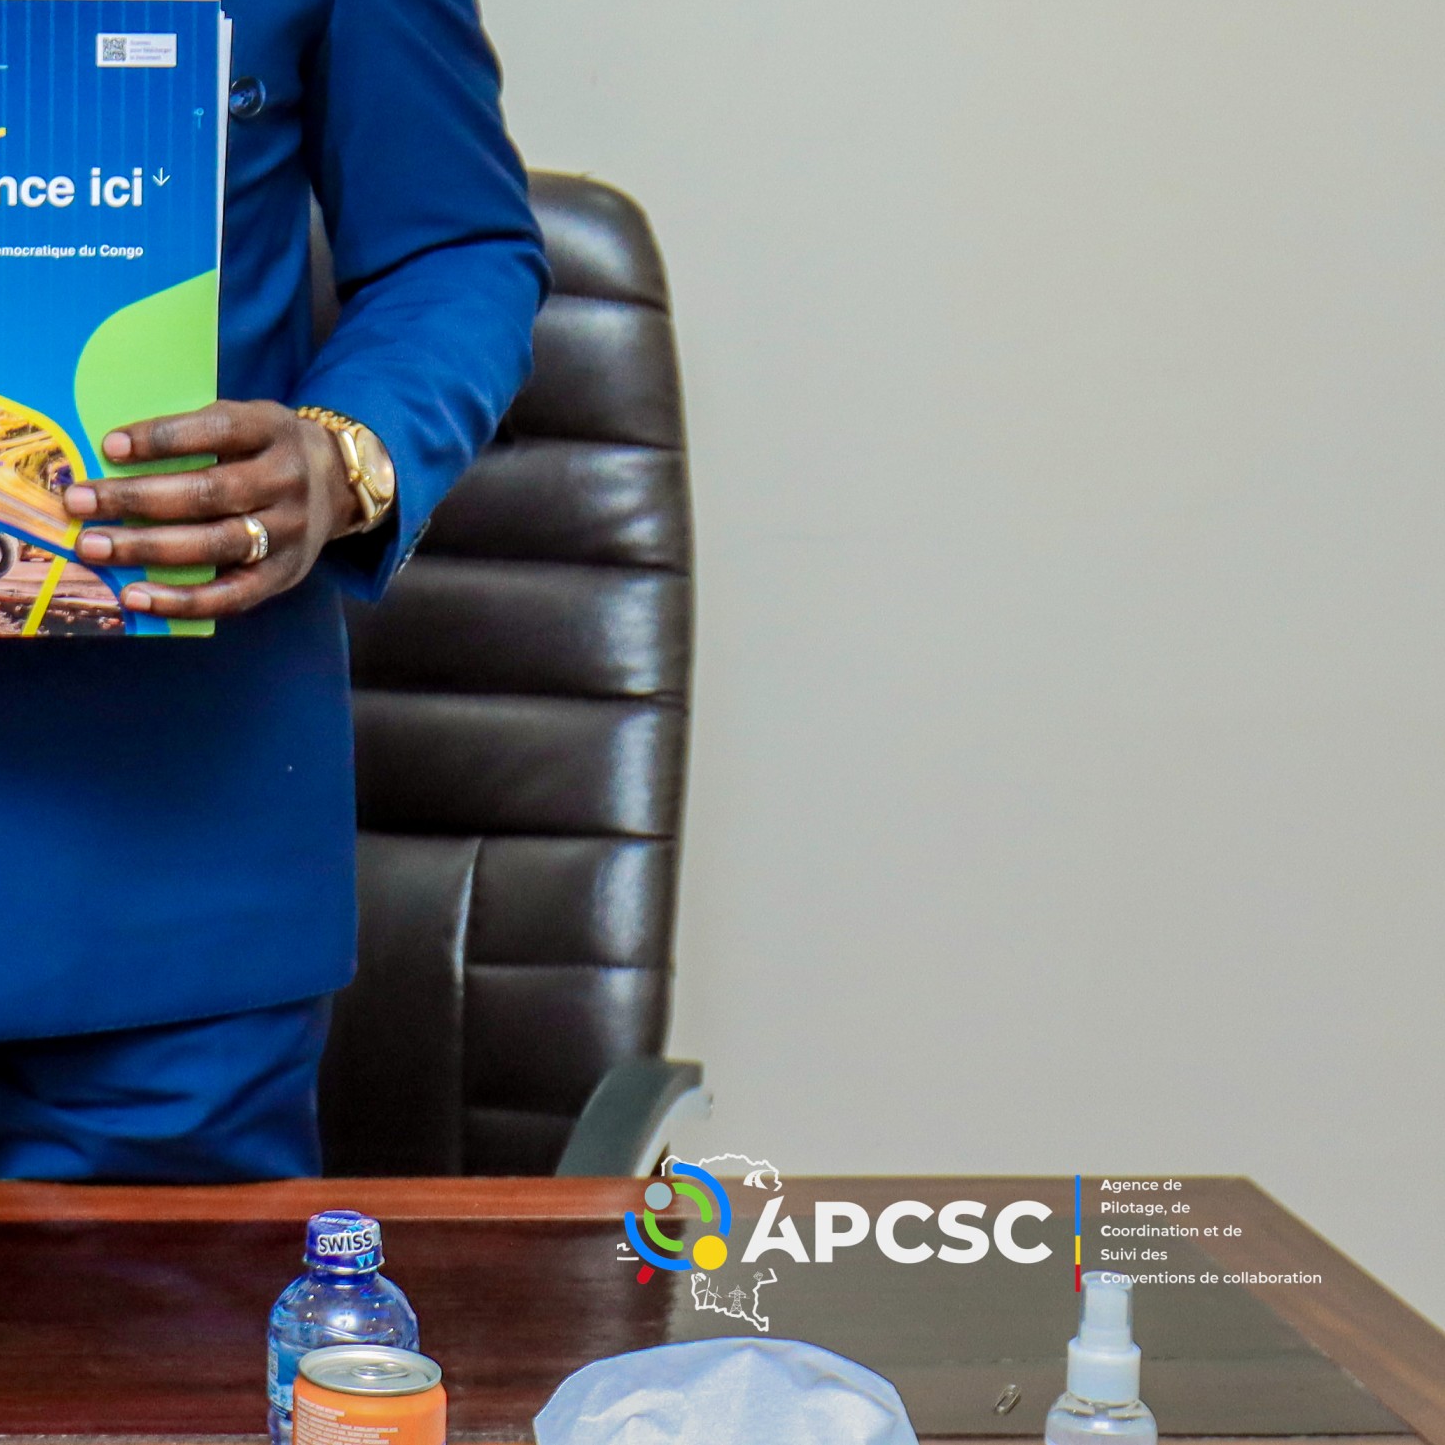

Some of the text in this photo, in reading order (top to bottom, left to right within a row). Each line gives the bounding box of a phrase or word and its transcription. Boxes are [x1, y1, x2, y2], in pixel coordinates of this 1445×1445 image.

[89, 166, 144, 206] ici
[78, 244, 96, 255] du
[99, 244, 144, 259] Congo
